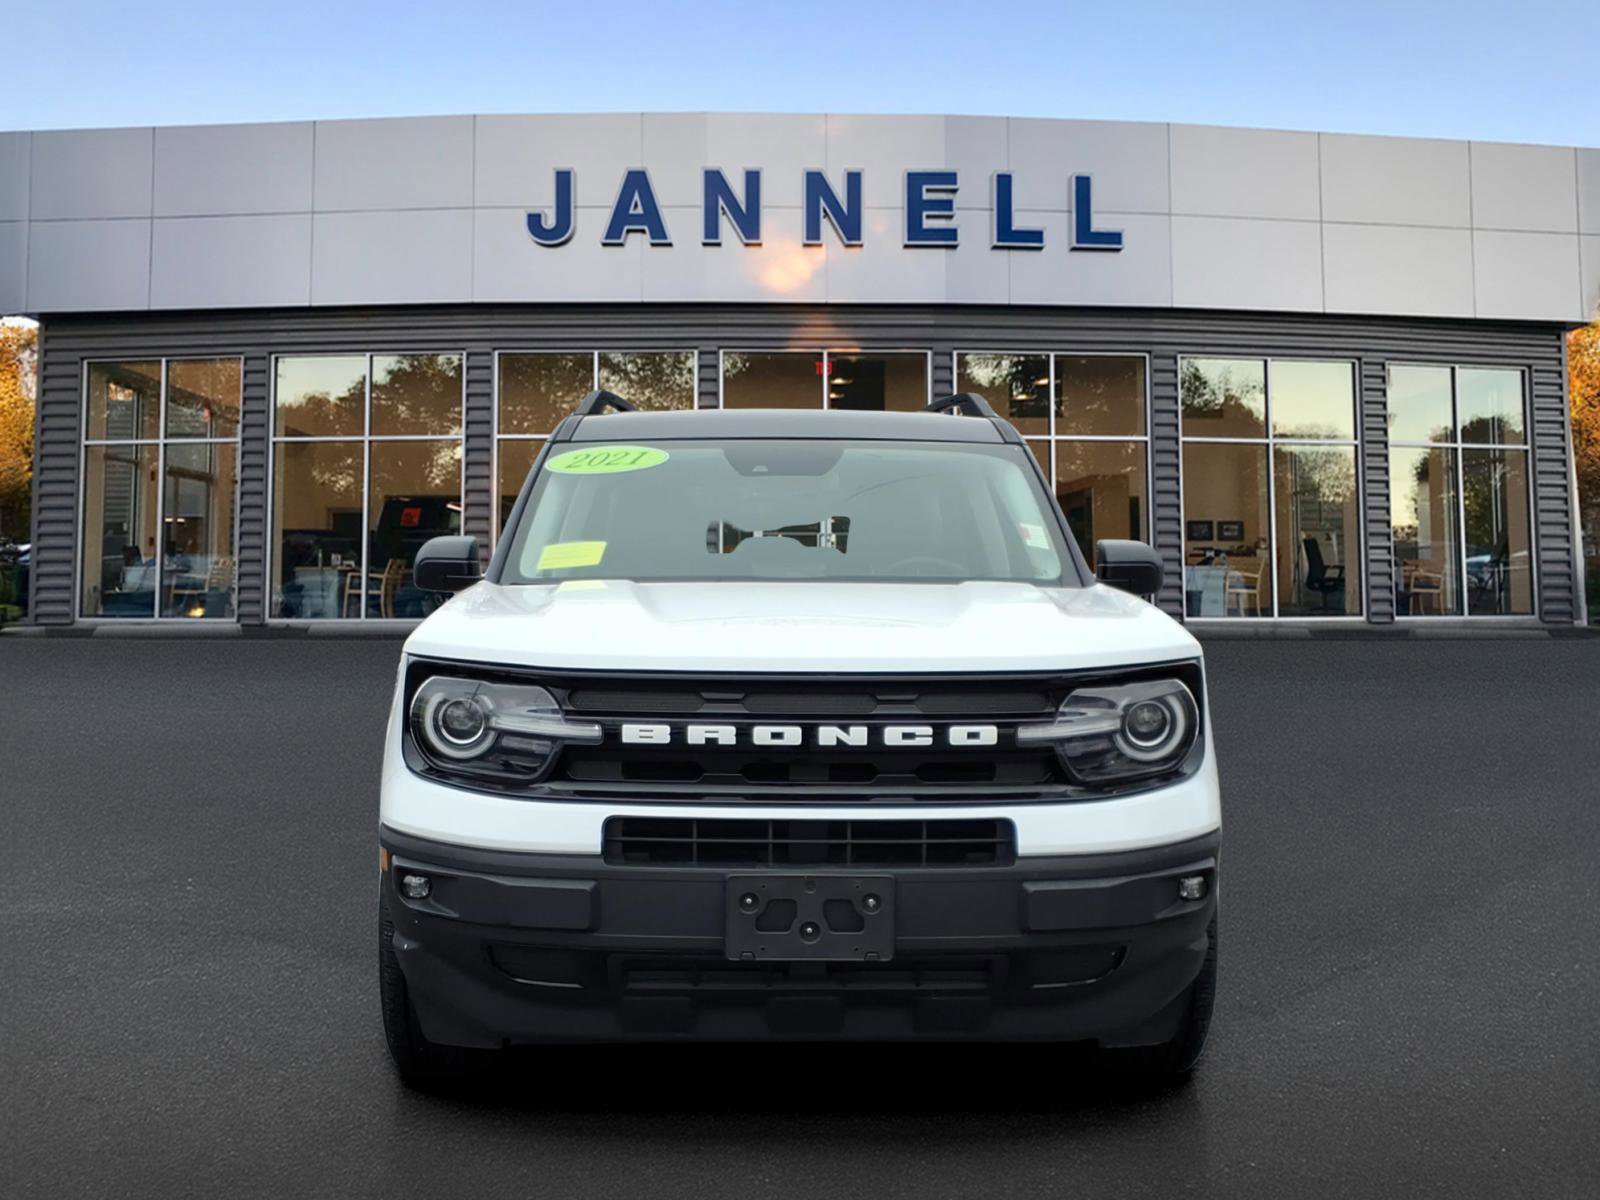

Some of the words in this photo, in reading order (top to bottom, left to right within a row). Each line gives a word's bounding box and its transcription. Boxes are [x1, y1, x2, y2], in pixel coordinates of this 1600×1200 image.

[526, 167, 1124, 250] JANNELL
[566, 452, 648, 469] 2021
[621, 722, 999, 747] BRONCO
